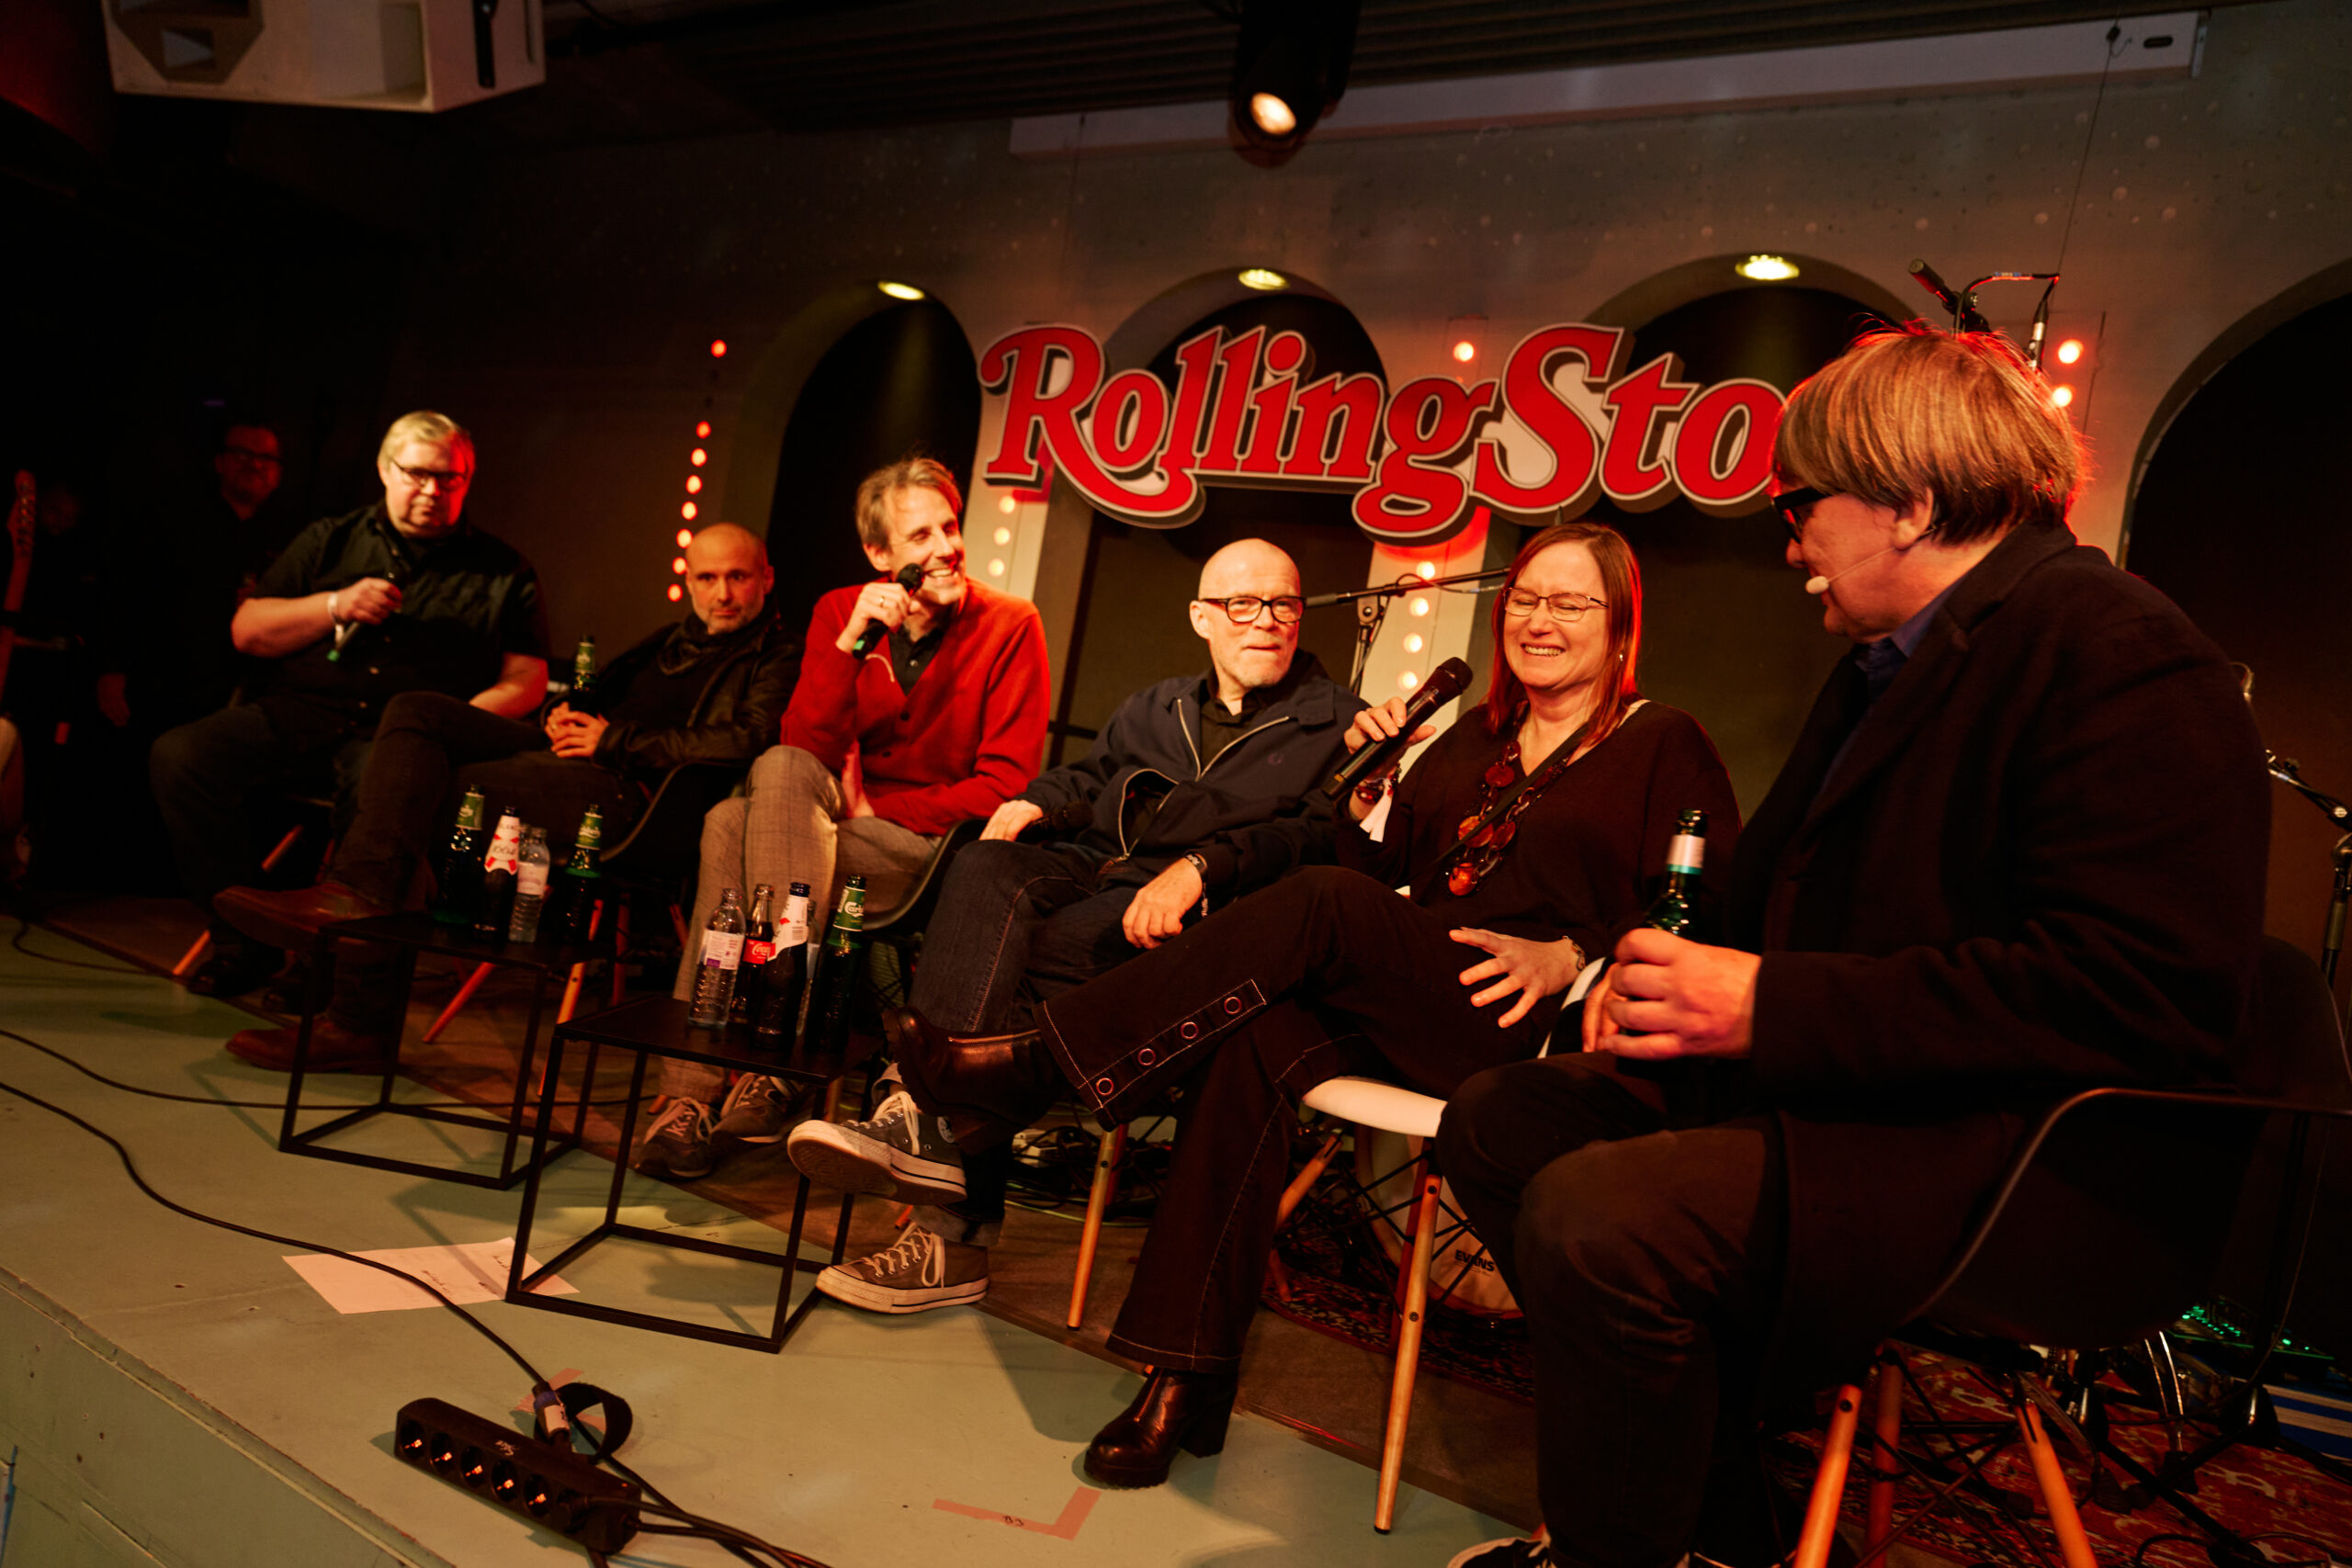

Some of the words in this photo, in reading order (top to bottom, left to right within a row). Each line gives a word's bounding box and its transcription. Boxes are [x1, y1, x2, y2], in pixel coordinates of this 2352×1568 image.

[978, 322, 1498, 538] Rolling
[1471, 323, 1787, 515] Sto
[1454, 1249, 1494, 1272] EVANS
